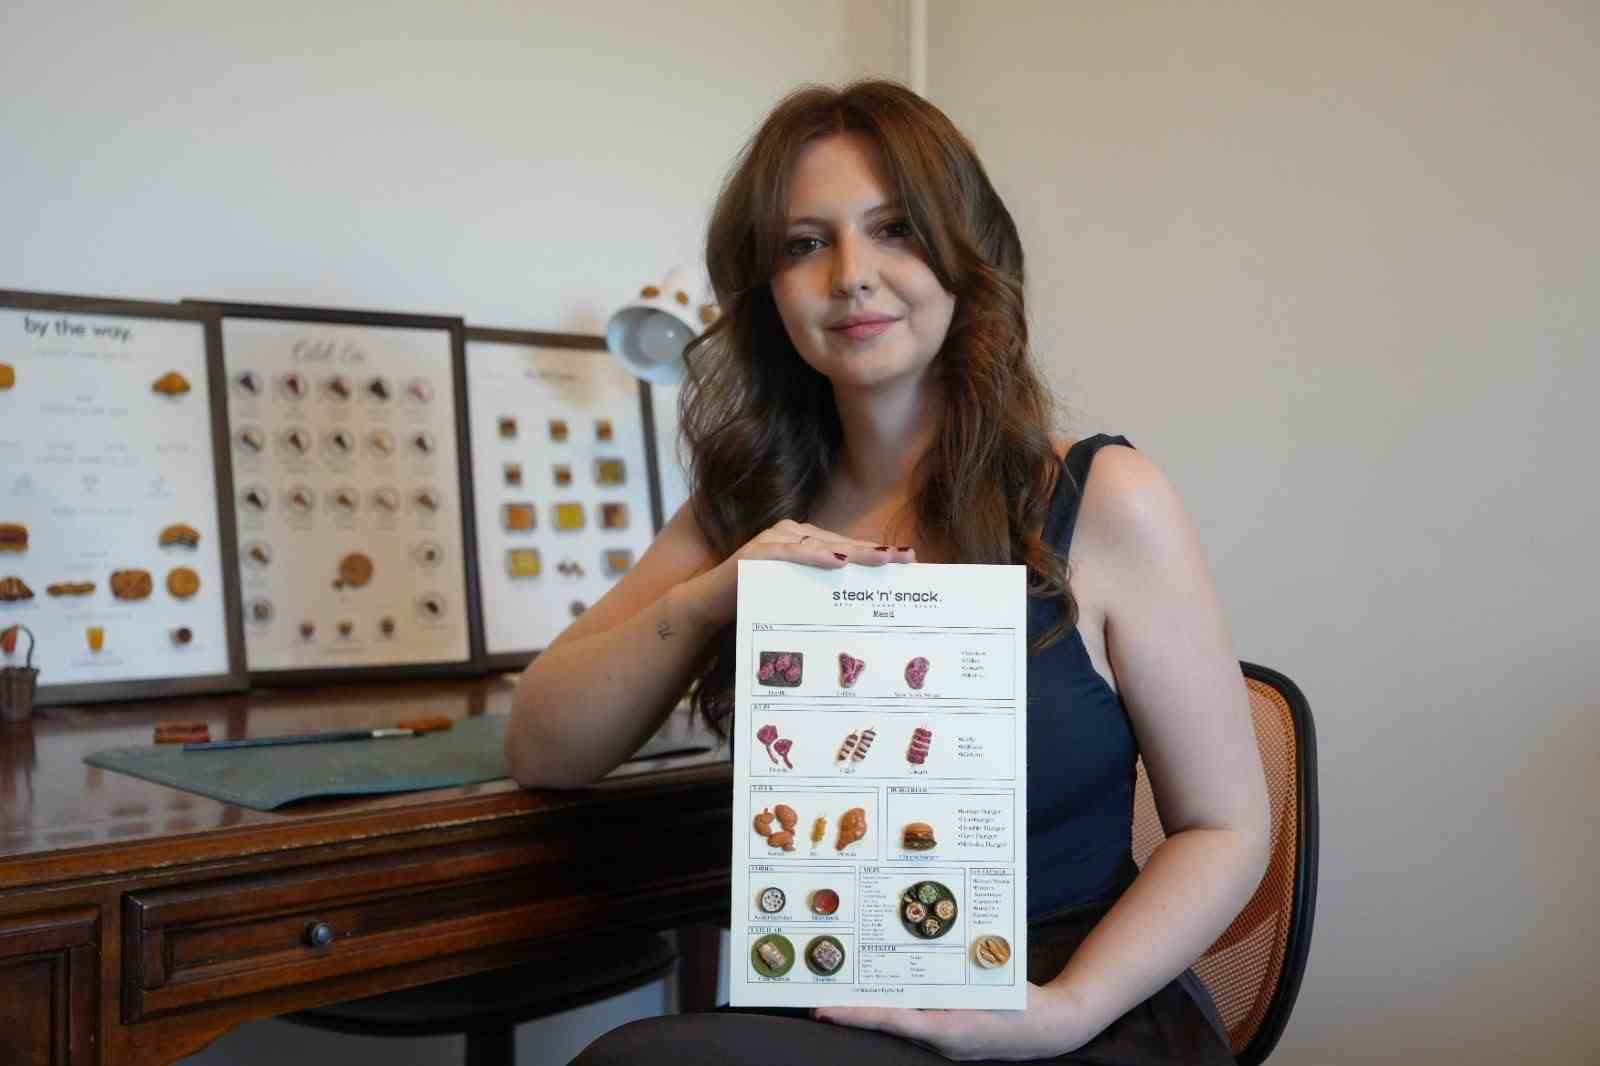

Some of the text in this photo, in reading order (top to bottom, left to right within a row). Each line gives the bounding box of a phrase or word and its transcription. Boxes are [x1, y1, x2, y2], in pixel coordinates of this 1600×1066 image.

[23, 315, 49, 338] by
[54, 319, 87, 337] the
[832, 589, 874, 601] steak
